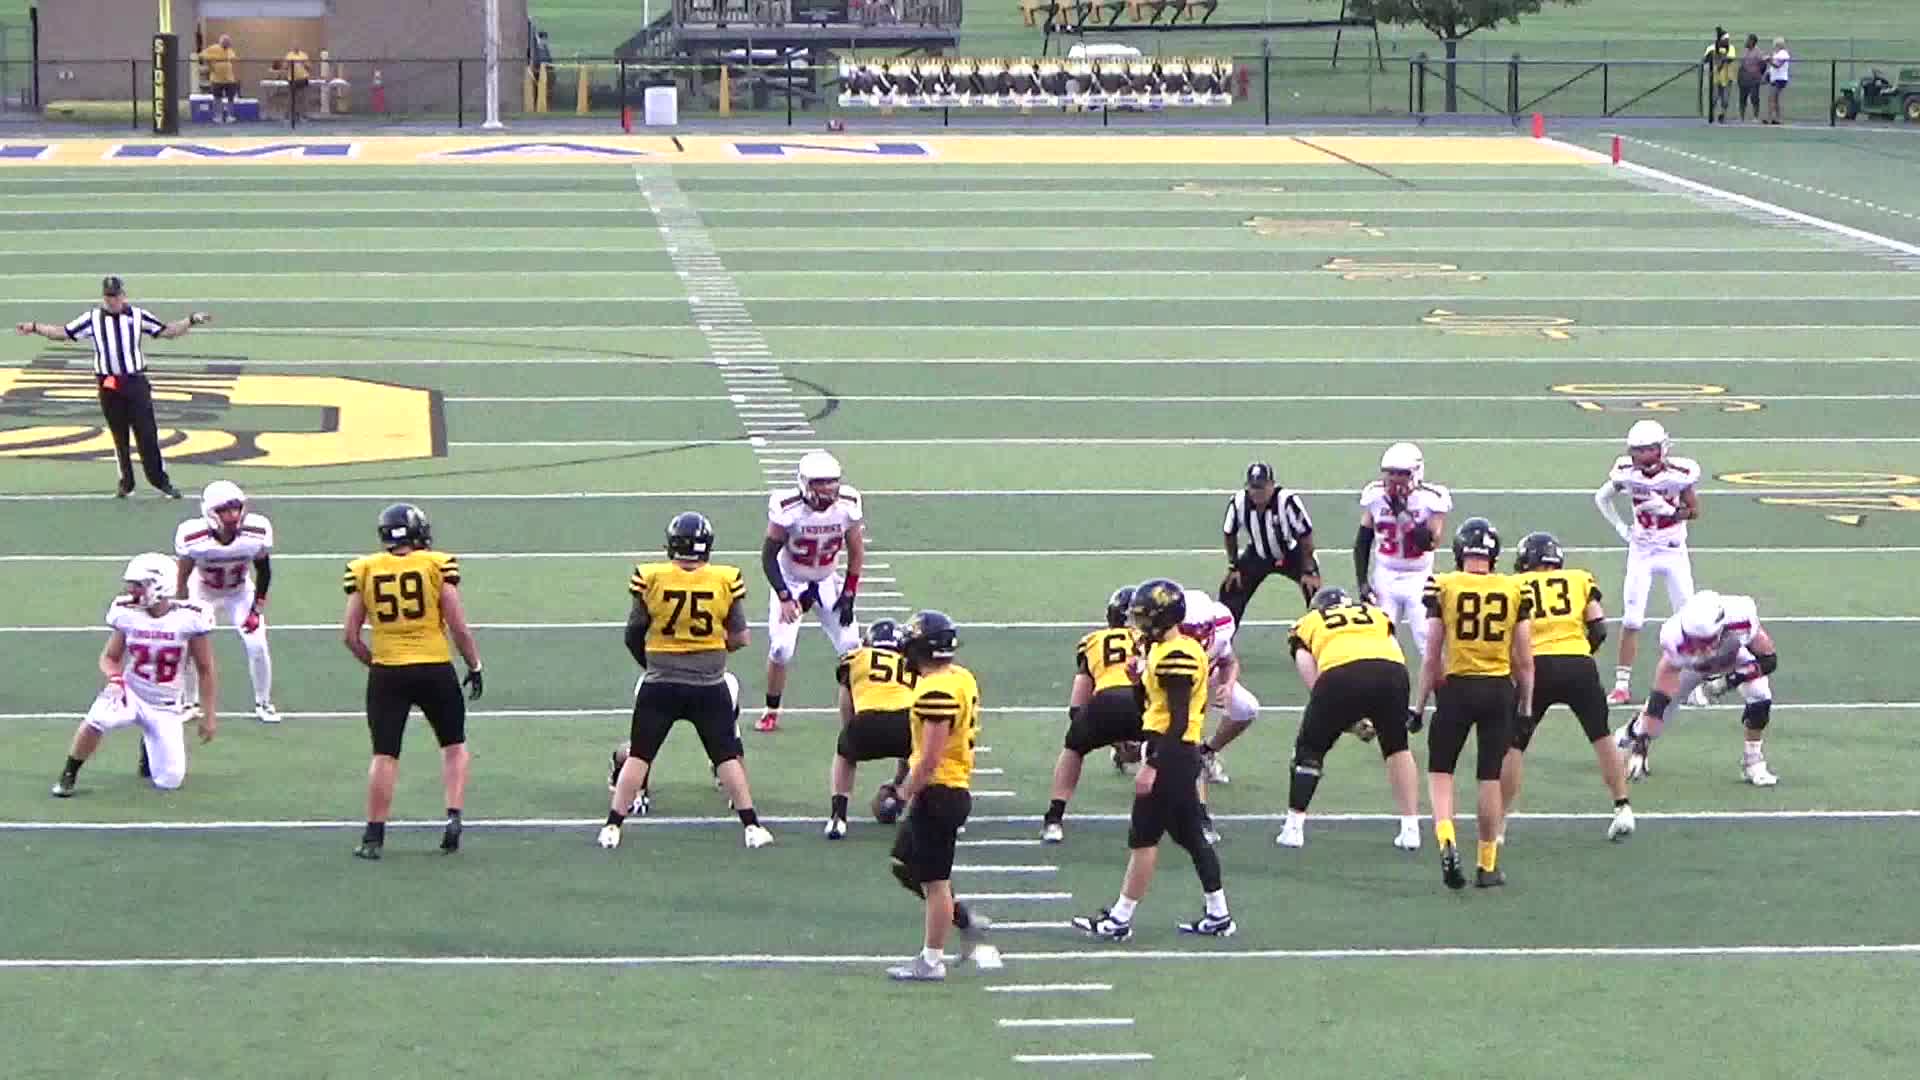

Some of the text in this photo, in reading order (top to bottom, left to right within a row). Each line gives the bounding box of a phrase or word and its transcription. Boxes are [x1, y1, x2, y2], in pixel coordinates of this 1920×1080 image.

[154, 38, 166, 130] SIDNEY
[374, 571, 425, 622] 59
[662, 590, 714, 636] 75
[1320, 604, 1375, 630] 53
[1456, 591, 1508, 641] 82
[1530, 577, 1571, 618] 13
